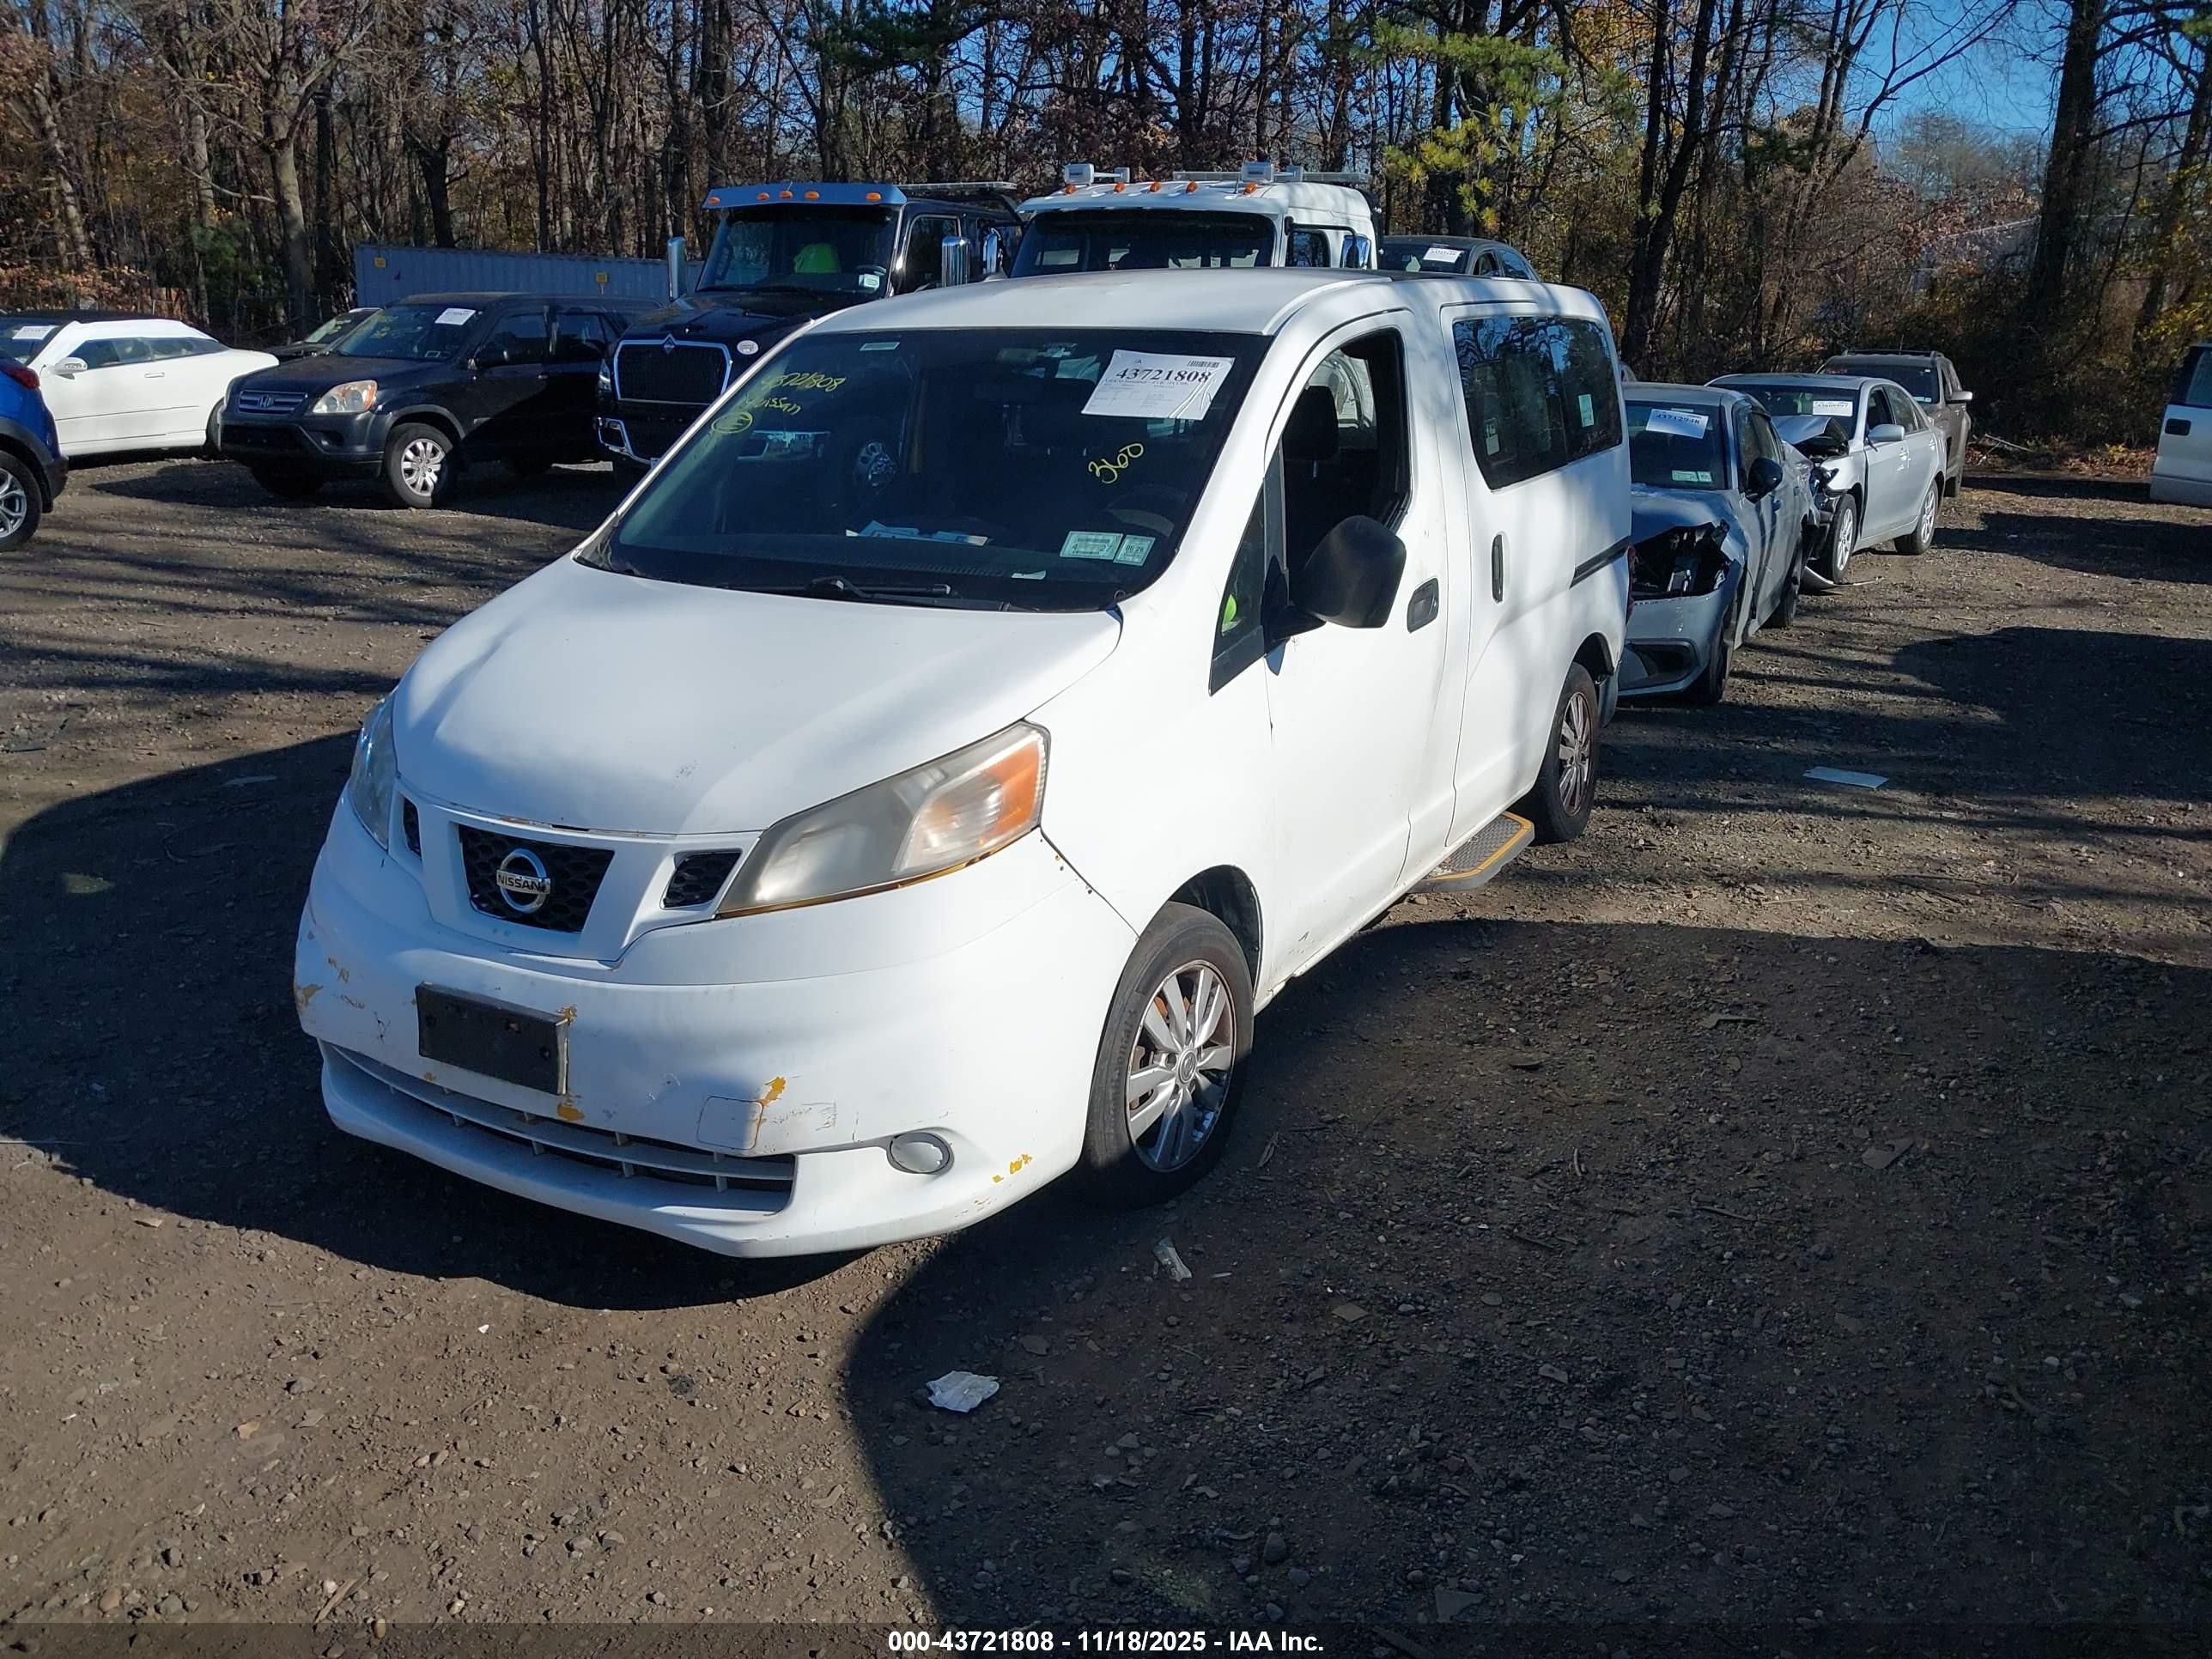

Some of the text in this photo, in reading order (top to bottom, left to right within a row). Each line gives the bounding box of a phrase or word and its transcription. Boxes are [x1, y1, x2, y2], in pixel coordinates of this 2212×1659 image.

[1116, 368, 1212, 383] 43721808
[1088, 442, 1145, 484] 360
[1099, 544, 1112, 552] 27
[498, 874, 542, 891] NISSAN
